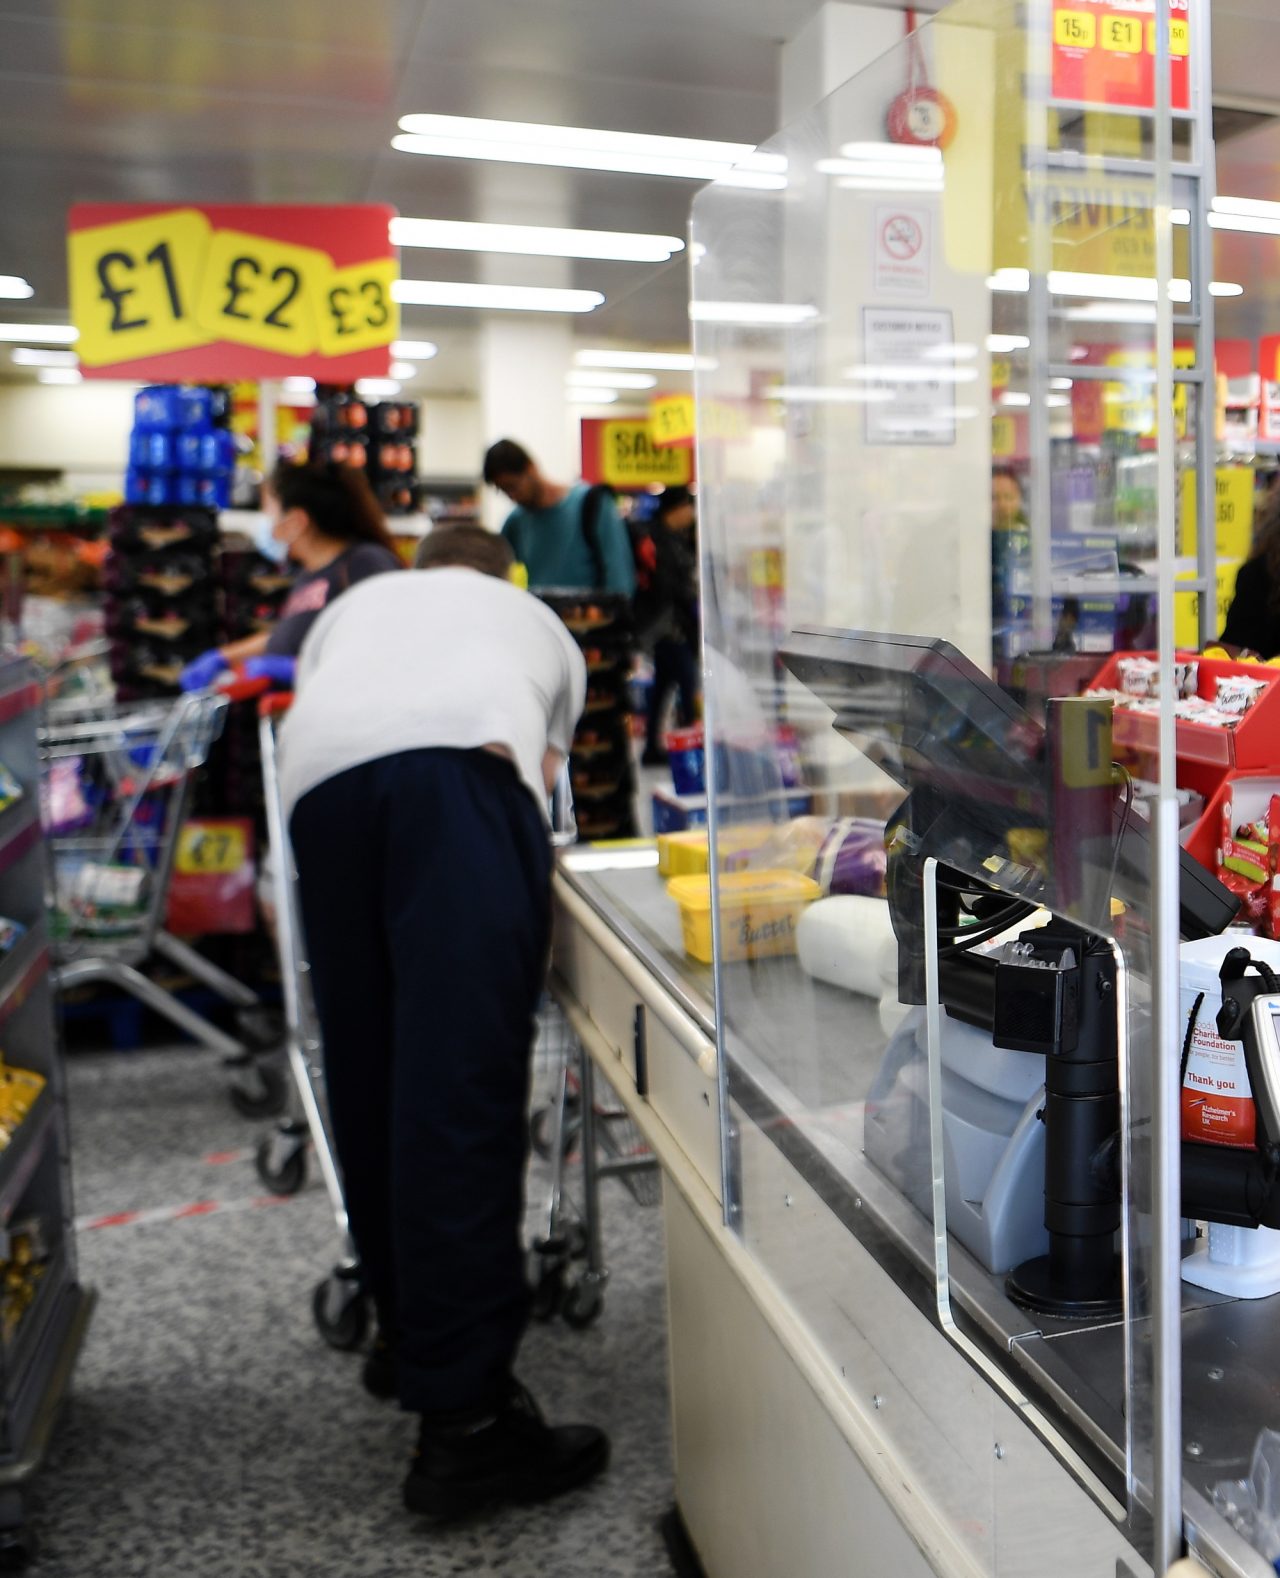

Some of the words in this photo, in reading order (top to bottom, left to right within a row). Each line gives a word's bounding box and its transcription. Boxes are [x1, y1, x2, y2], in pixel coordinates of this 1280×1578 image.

[1063, 18, 1088, 39] 15p
[1111, 21, 1132, 43] £1
[96, 241, 183, 333] £1
[223, 256, 301, 331] £2
[327, 280, 388, 336] £3
[1193, 1027, 1221, 1040] Charita
[1193, 1036, 1236, 1051] Foundation
[1187, 1072, 1214, 1087] Thank
[1216, 1079, 1236, 1090] you
[1201, 1104, 1236, 1117] Alzheimer's
[1201, 1111, 1229, 1122] Research
[1201, 1117, 1211, 1126] UK
